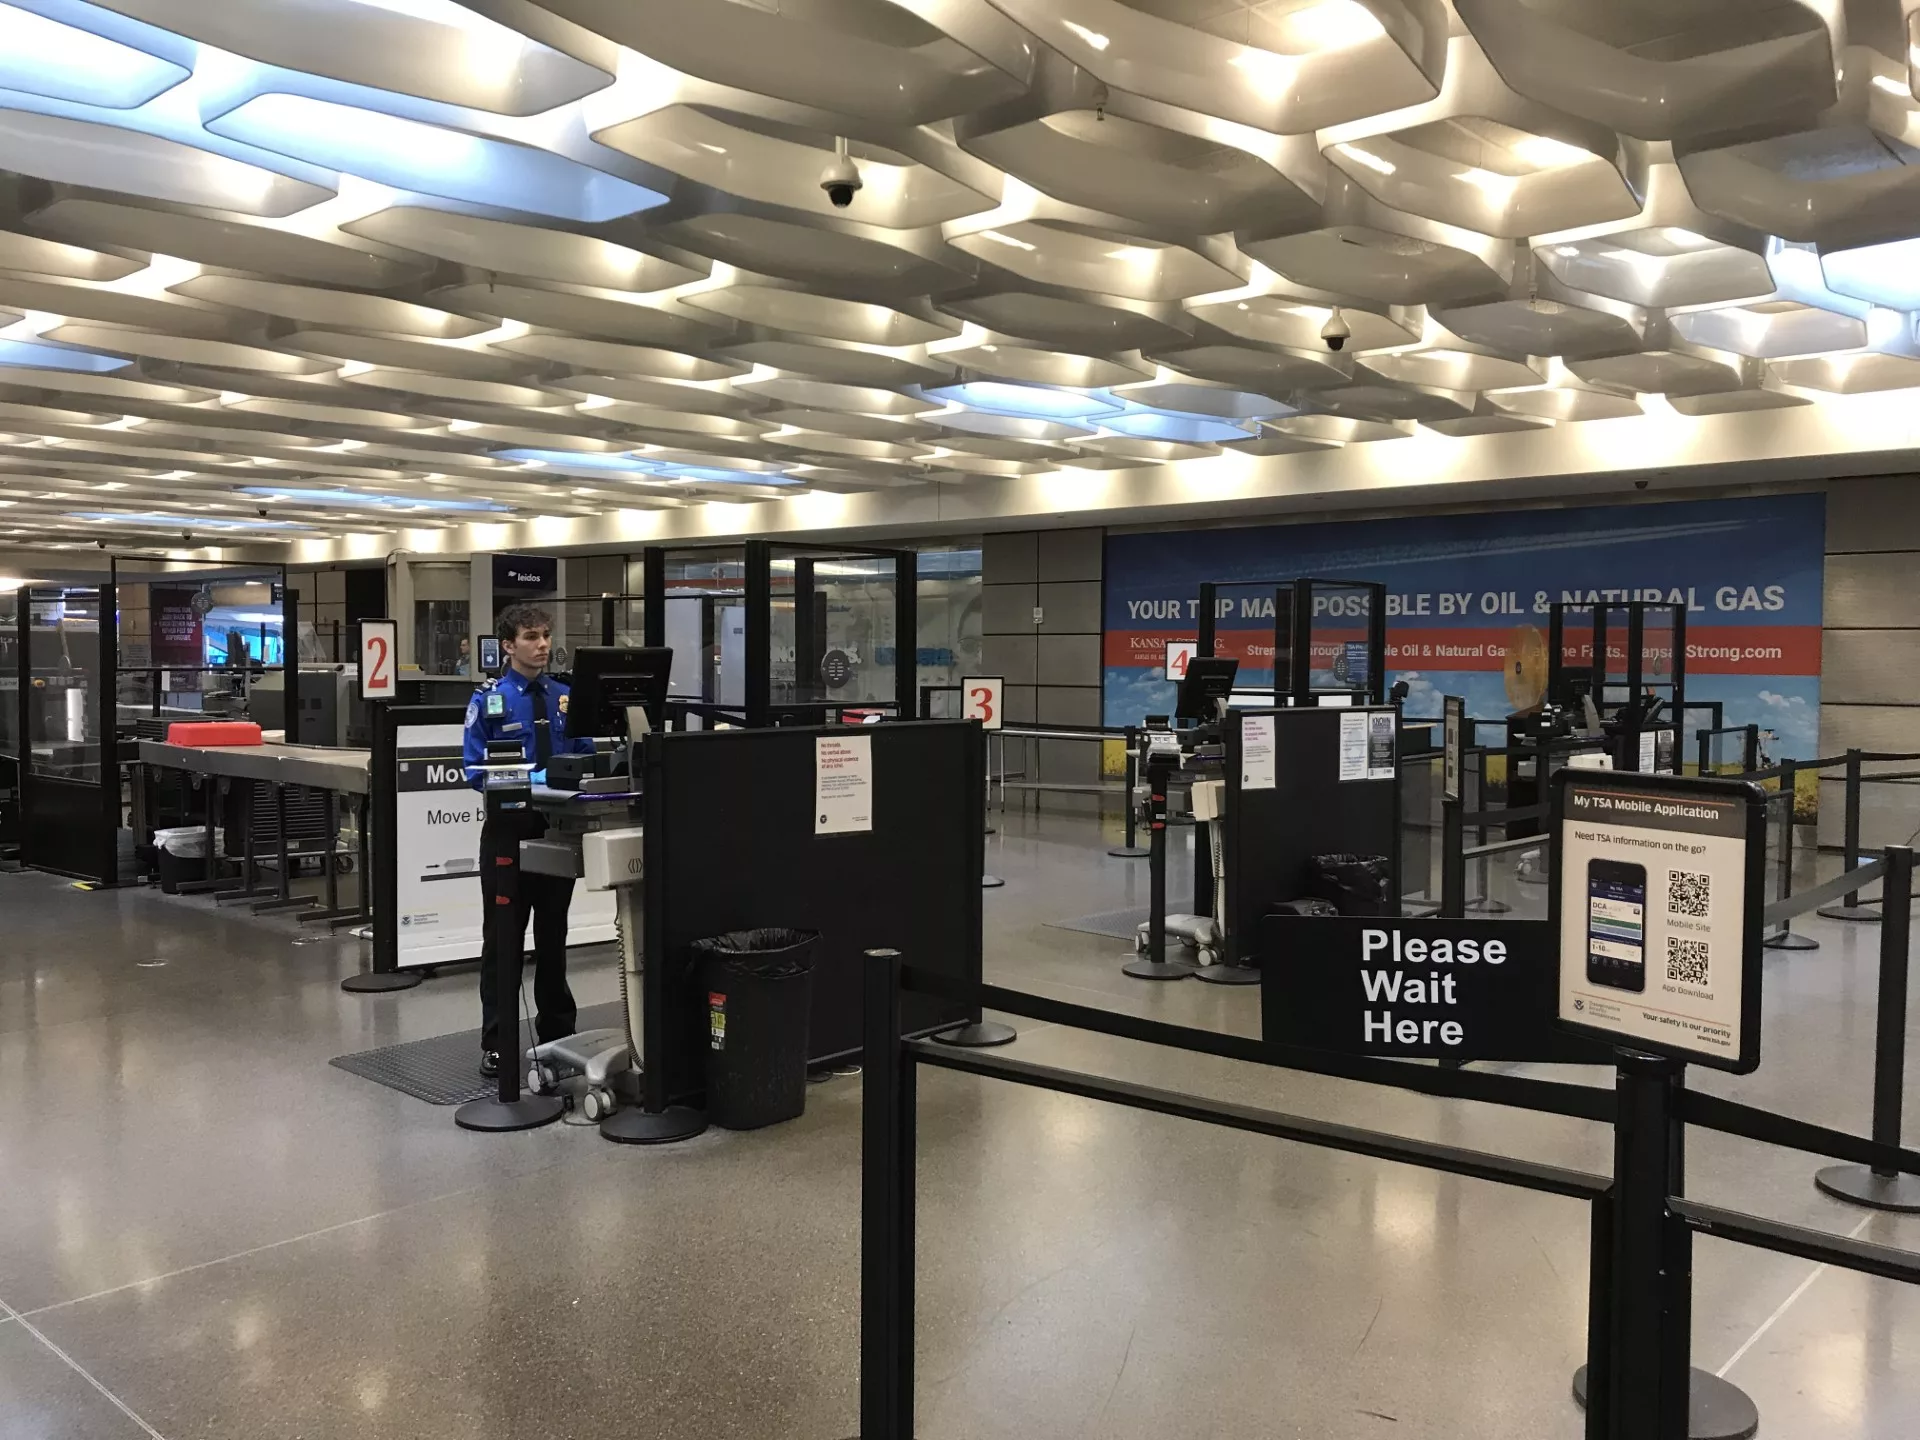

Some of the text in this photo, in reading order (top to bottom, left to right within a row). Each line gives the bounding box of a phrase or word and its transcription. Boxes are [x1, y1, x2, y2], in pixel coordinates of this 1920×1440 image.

[518, 573, 541, 582] leidos
[1127, 585, 1785, 619] YOUR TIP MA POSSBLE BY OIL & NATURAL GAS
[367, 636, 389, 689] 2
[1171, 649, 1188, 676] 4
[1247, 644, 1276, 656] Stren
[1401, 644, 1419, 657] Oil
[1422, 644, 1433, 657] &
[1436, 644, 1483, 657] Natural
[1581, 644, 1625, 658] Fats.
[970, 687, 993, 723] 3
[427, 764, 468, 784] Mov
[427, 809, 471, 825] Move
[1574, 795, 1719, 820] My TSA Mobile Application
[1575, 831, 1706, 854] Need TSA information on the go?
[1592, 901, 1607, 910] DCA
[1666, 919, 1711, 932] Mobile Site
[1362, 929, 1507, 964] Please
[1360, 969, 1457, 1005] Wait
[1662, 983, 1714, 1000] App Download
[1363, 1010, 1464, 1046] Here
[1642, 1012, 1731, 1039] Your safety is our priority
